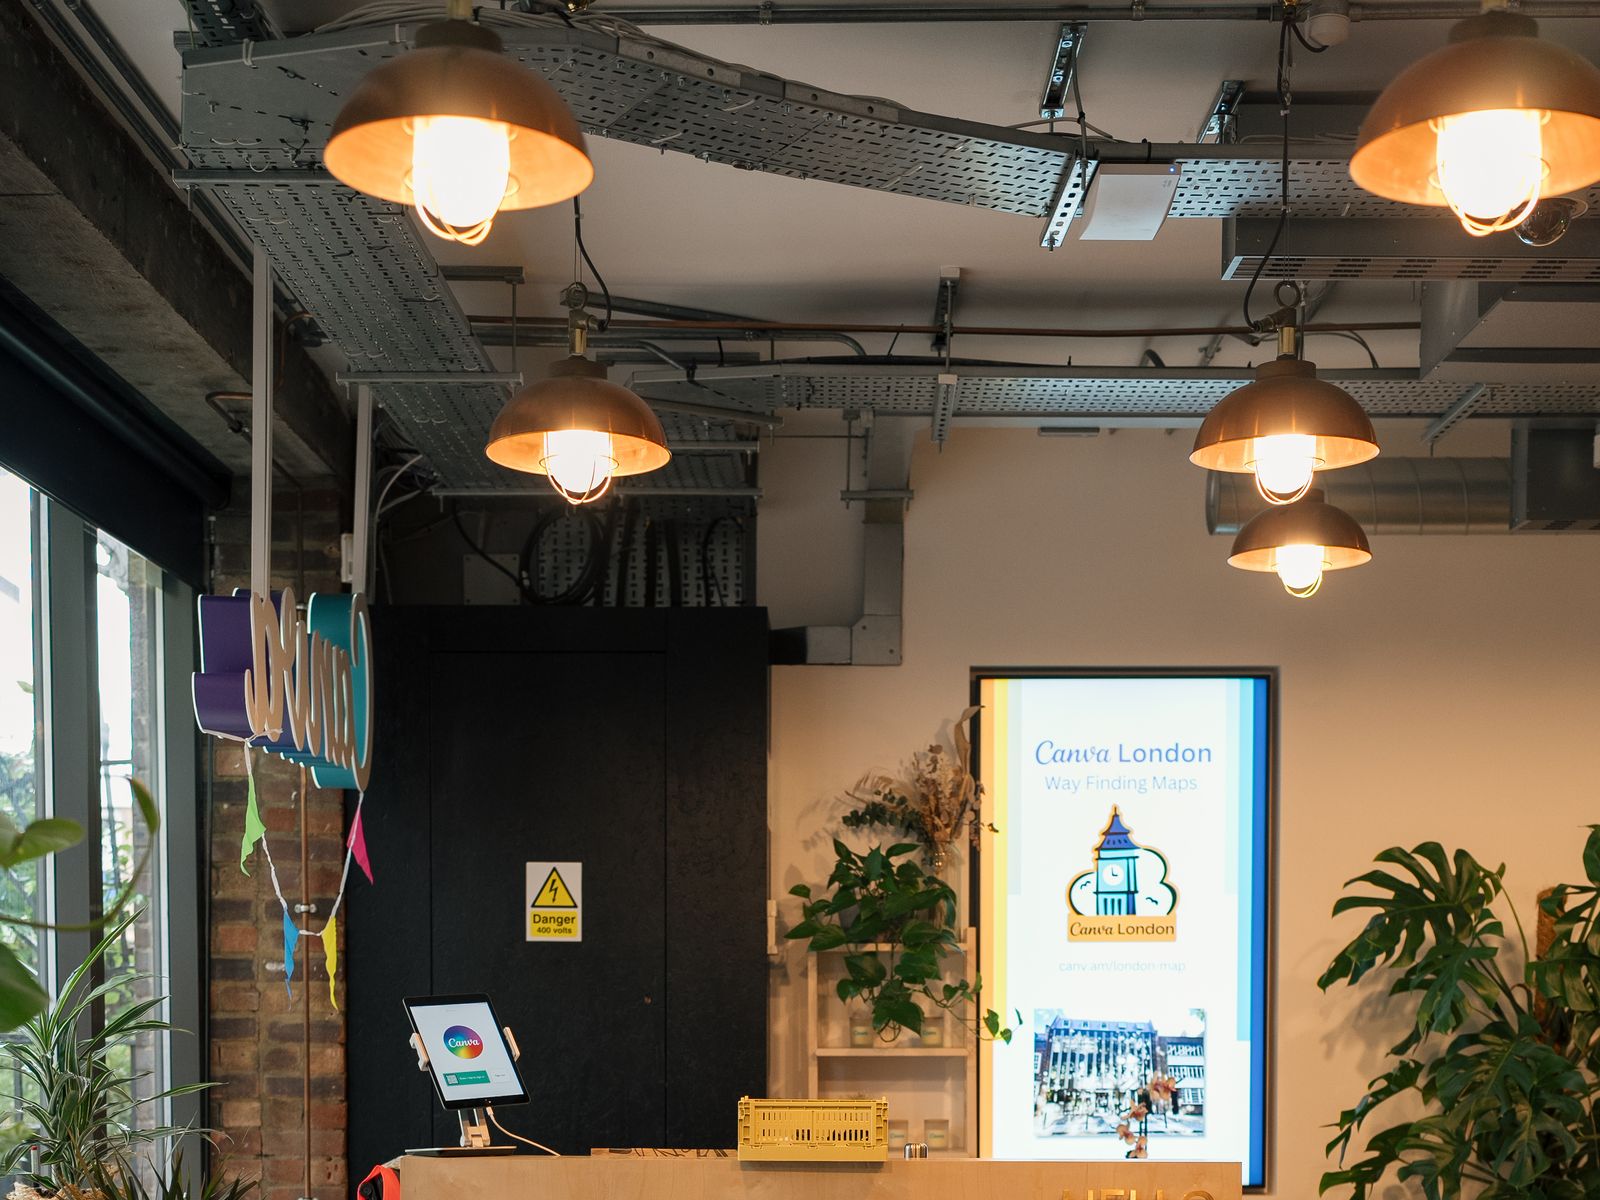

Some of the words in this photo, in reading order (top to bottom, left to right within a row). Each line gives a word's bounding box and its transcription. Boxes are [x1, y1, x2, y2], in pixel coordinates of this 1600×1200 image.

[1035, 740, 1110, 765] Canva
[1119, 743, 1212, 763] London
[1045, 776, 1081, 794] Way
[1086, 775, 1147, 794] Finding
[1152, 776, 1198, 793] Maps
[533, 914, 576, 926] Danger
[1070, 922, 1113, 936] Canva
[1118, 923, 1175, 935] London
[448, 1038, 480, 1048] Canva
